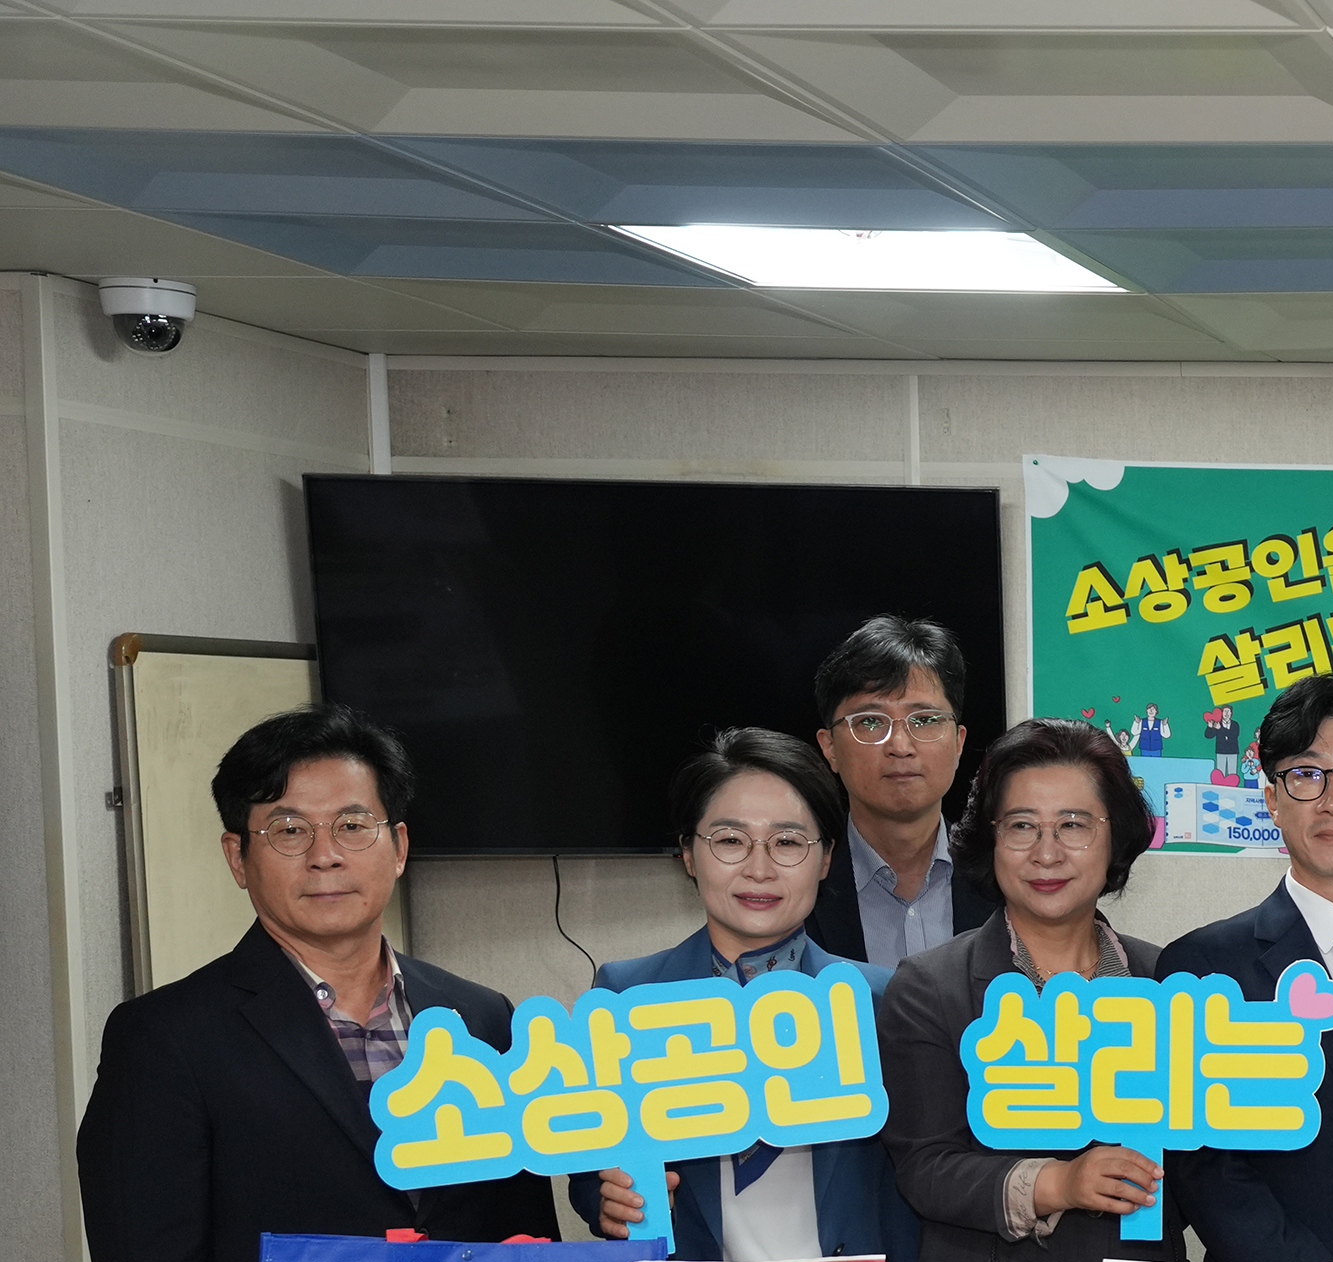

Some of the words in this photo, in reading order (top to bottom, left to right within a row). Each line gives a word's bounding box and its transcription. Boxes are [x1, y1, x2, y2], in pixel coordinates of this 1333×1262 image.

[1226, 825, 1280, 842] 150,000
[387, 980, 872, 1170] 소상공인
[977, 989, 1310, 1132] 살리는
